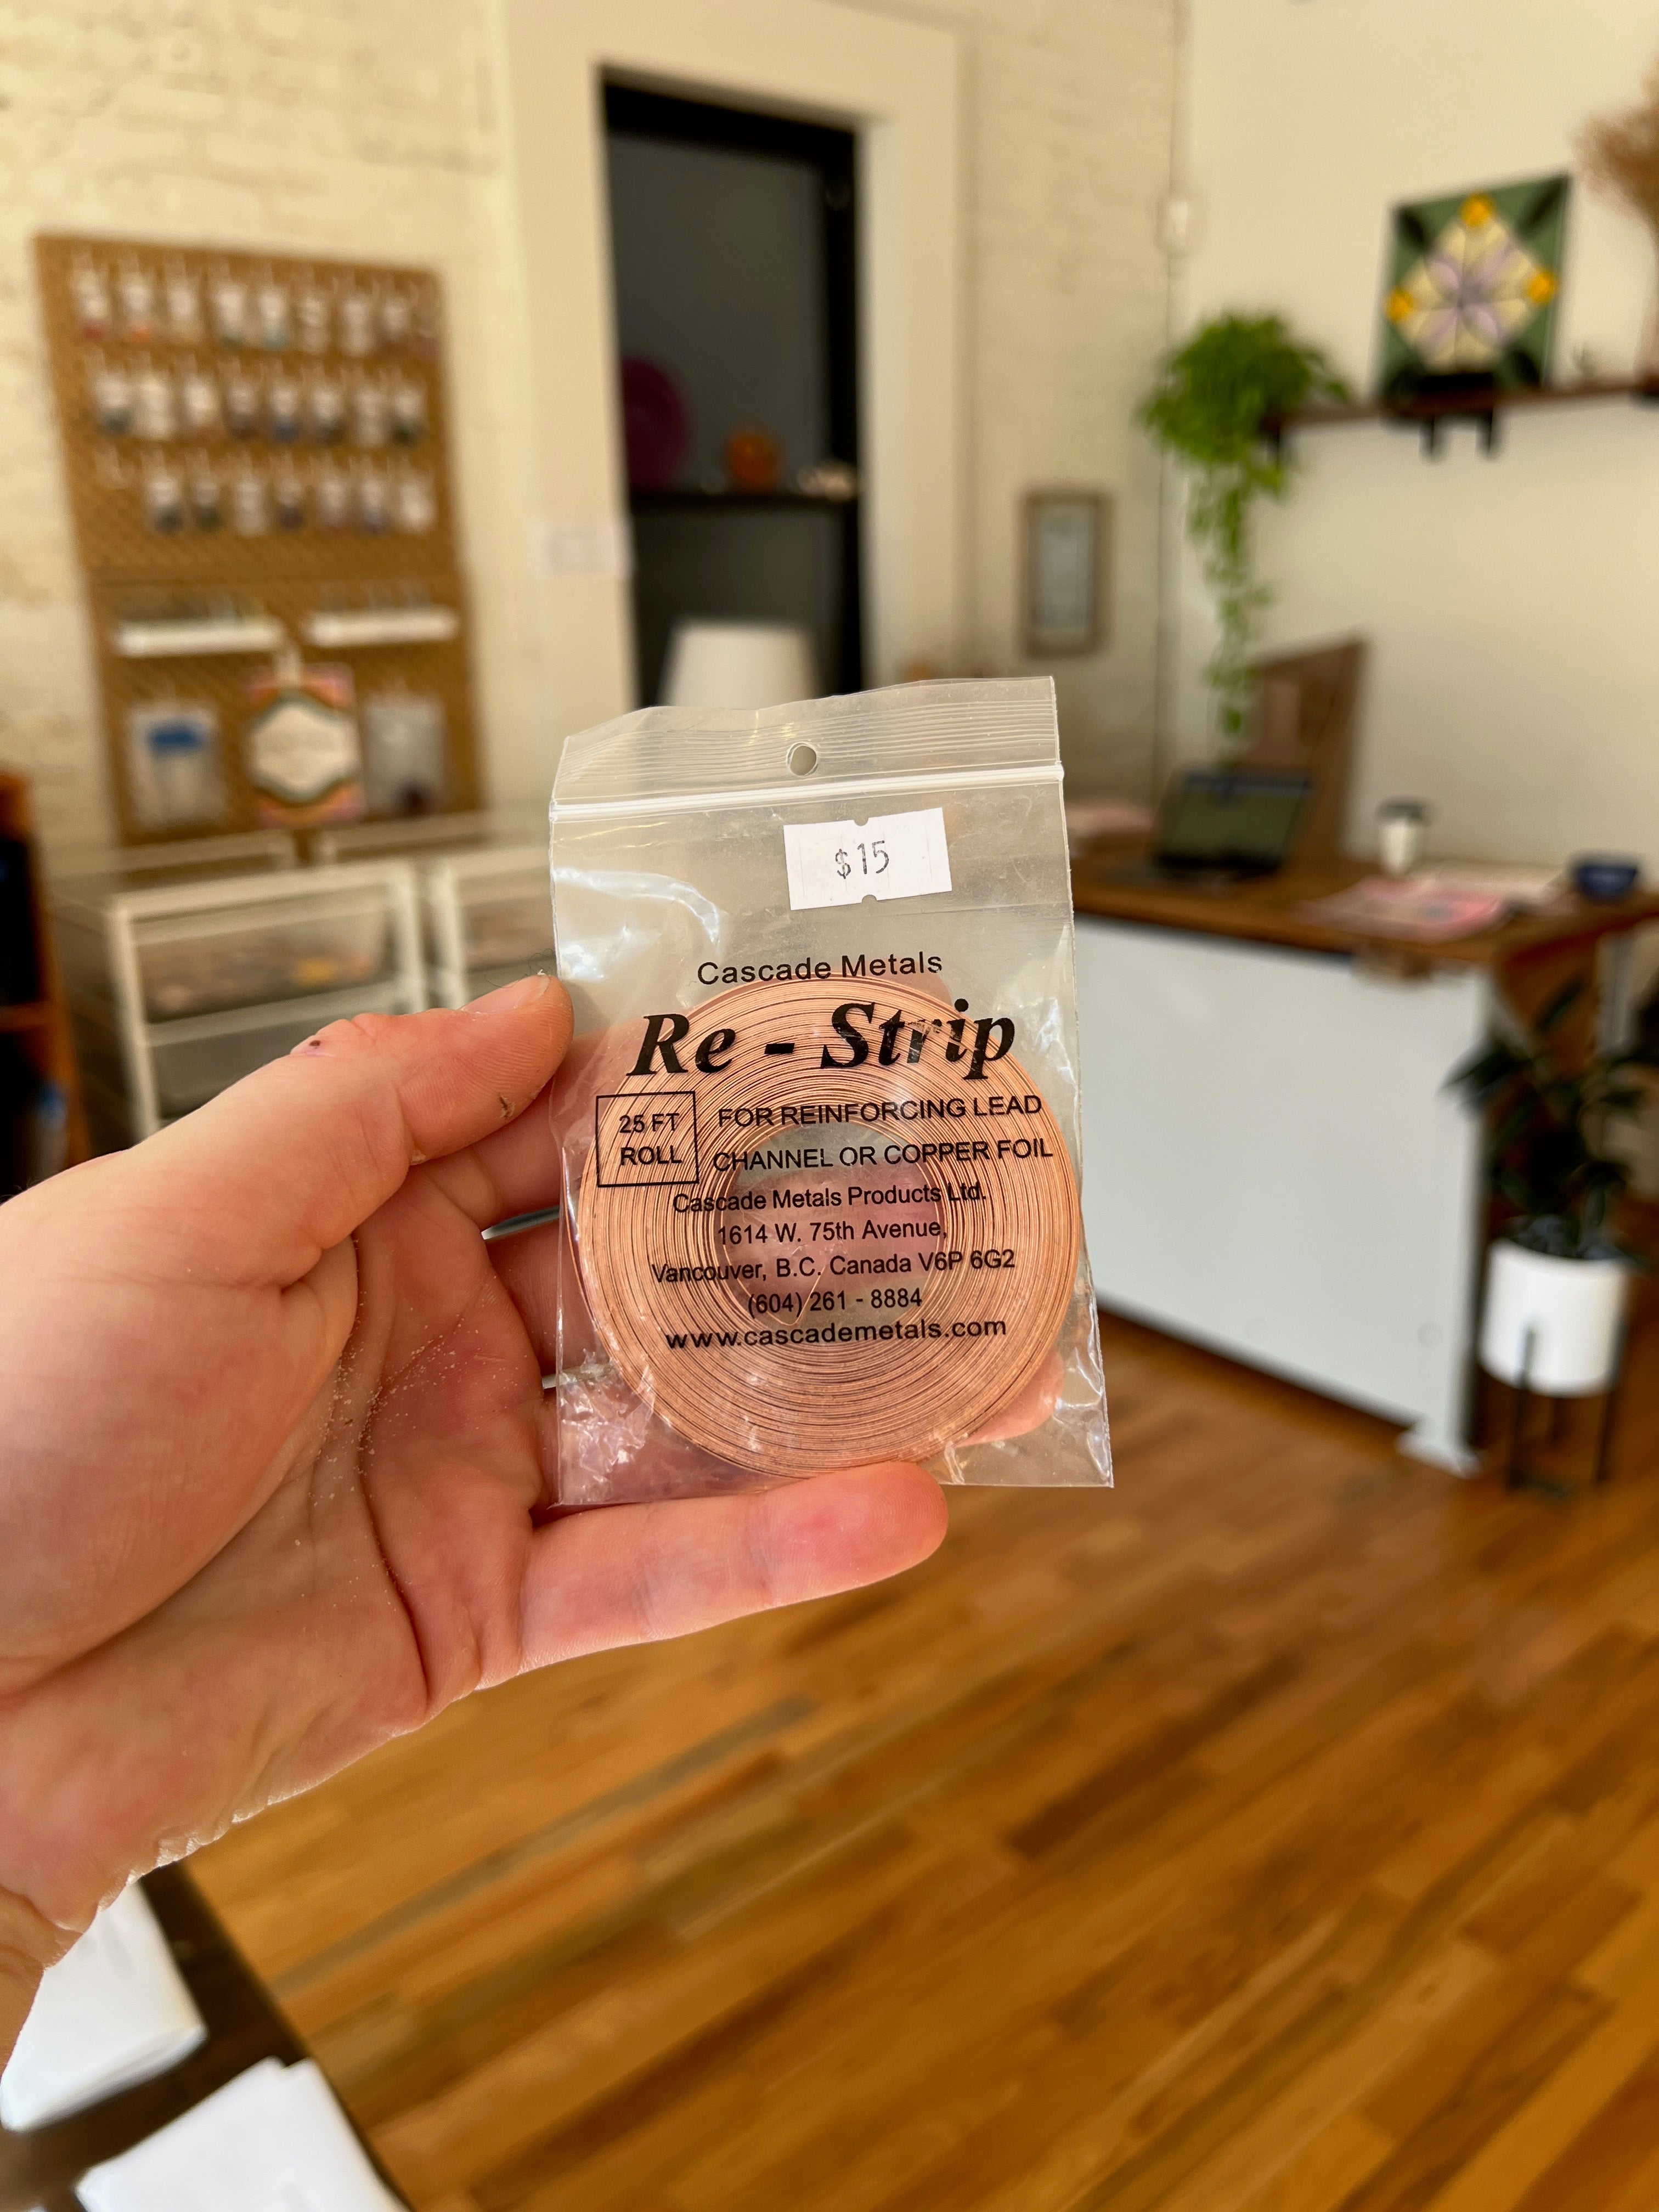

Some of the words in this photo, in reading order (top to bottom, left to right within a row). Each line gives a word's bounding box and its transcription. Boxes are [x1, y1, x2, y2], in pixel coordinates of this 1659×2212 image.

[835, 840, 890, 879] $15
[697, 957, 831, 985] Cascade
[842, 951, 943, 978] Metals
[628, 1013, 735, 1076] Re
[765, 1042, 795, 1056] -
[820, 998, 1015, 1080] Strip
[619, 1114, 646, 1134] 25
[652, 1112, 680, 1132] FT
[719, 1108, 774, 1128] FOR
[781, 1098, 966, 1125] REINFORCING
[974, 1096, 1042, 1116] LEAD
[620, 1146, 682, 1166] ROLL
[713, 1149, 832, 1171] CHANNEL
[839, 1146, 876, 1166] OR
[884, 1142, 990, 1164] COPPER
[998, 1138, 1052, 1159] FOIL
[673, 1191, 766, 1212] Cascade
[773, 1188, 841, 1209] Metals
[848, 1185, 941, 1206] Products
[948, 1180, 986, 1202] Ltd.
[718, 1224, 768, 1244] 1614
[775, 1223, 802, 1243] W.
[810, 1221, 854, 1242] 75th
[862, 1219, 947, 1239] Avenue,
[652, 1263, 767, 1282] Vancouver,
[776, 1256, 822, 1278] B.C.
[830, 1254, 911, 1275] Canada
[918, 1251, 963, 1271] V6P
[970, 1249, 1015, 1268] 6G2
[748, 1291, 803, 1317] (604)
[810, 1290, 847, 1310] 261
[871, 1288, 922, 1308] 8884
[667, 1318, 1006, 1348] www.cascademetals.com
